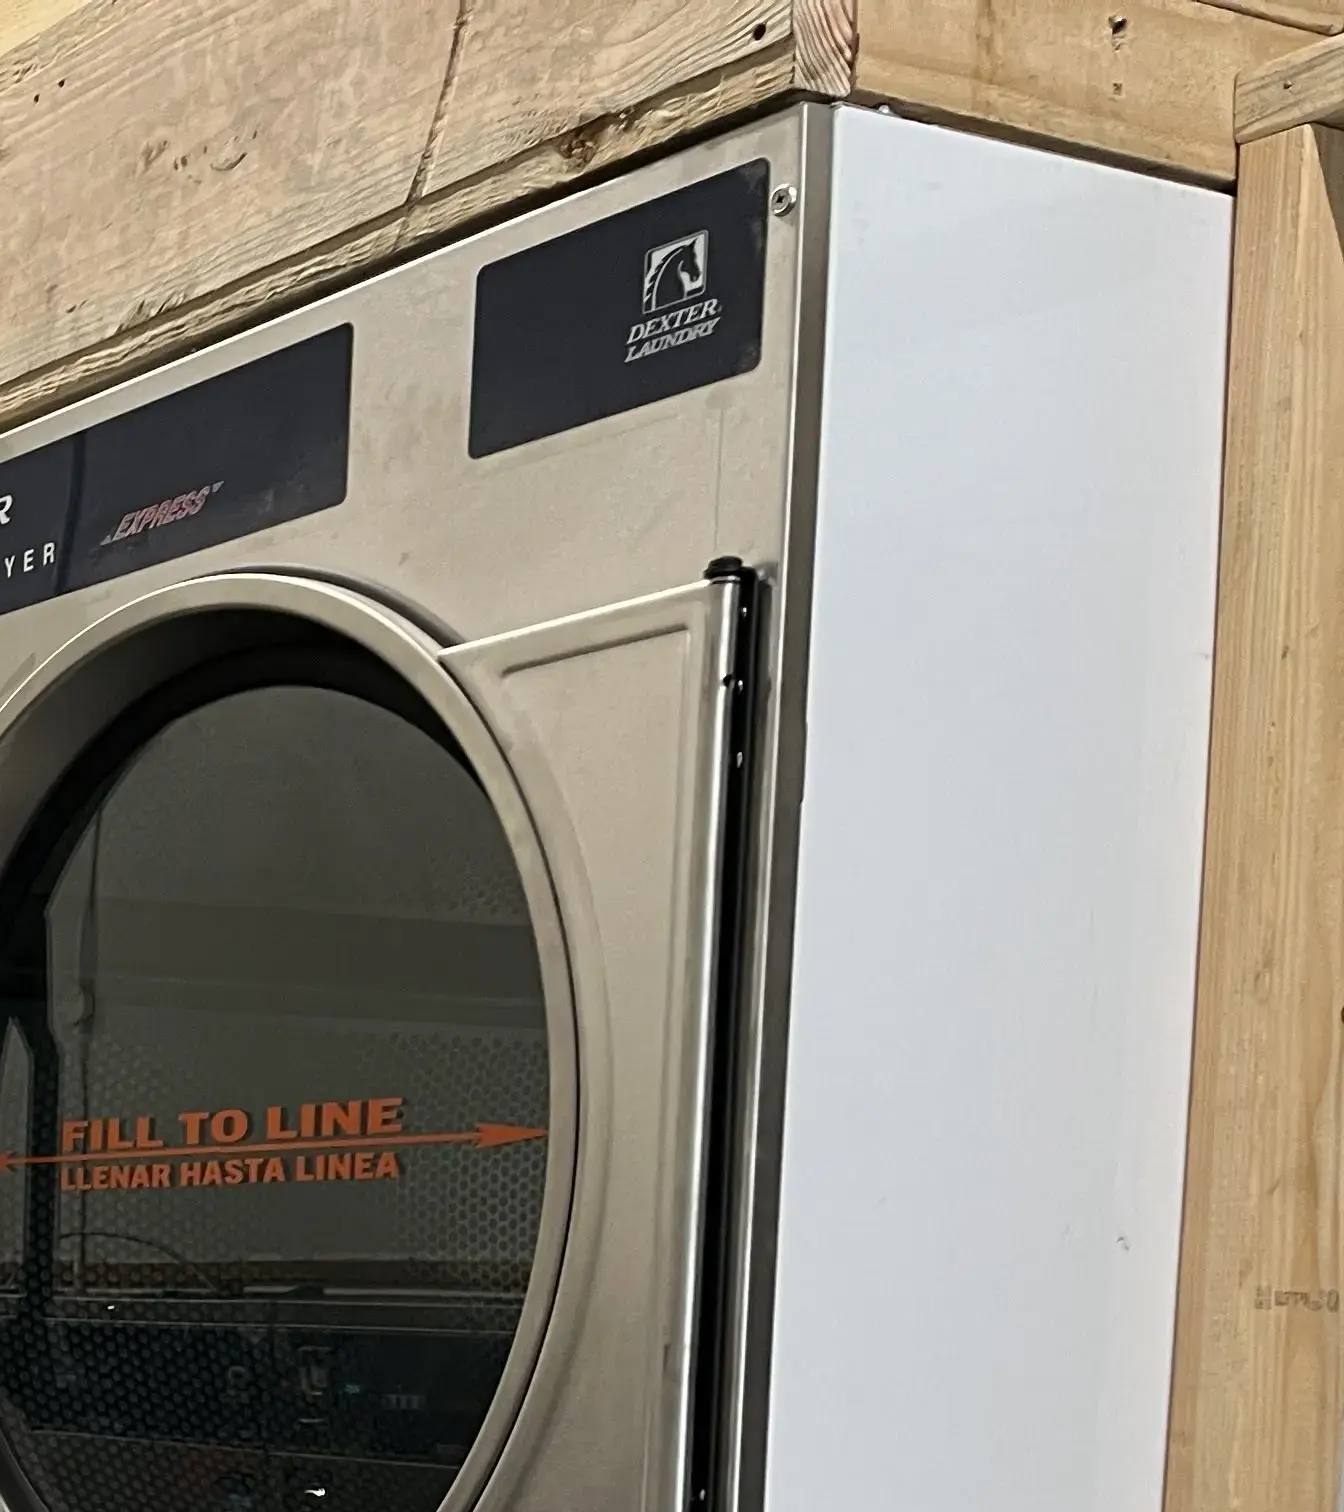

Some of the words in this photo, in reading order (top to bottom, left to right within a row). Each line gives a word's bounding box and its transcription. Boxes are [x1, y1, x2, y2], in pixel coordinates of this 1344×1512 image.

[624, 317, 722, 363] LAUNDRY
[626, 298, 719, 345] DEXTER
[112, 484, 211, 540] EXPRESS
[62, 1119, 164, 1153] FILL
[178, 1107, 250, 1146] TO
[266, 1098, 404, 1141] LINE
[61, 1163, 170, 1191] LLENAR
[180, 1156, 285, 1187] HASTA
[296, 1152, 400, 1182] LINEA
